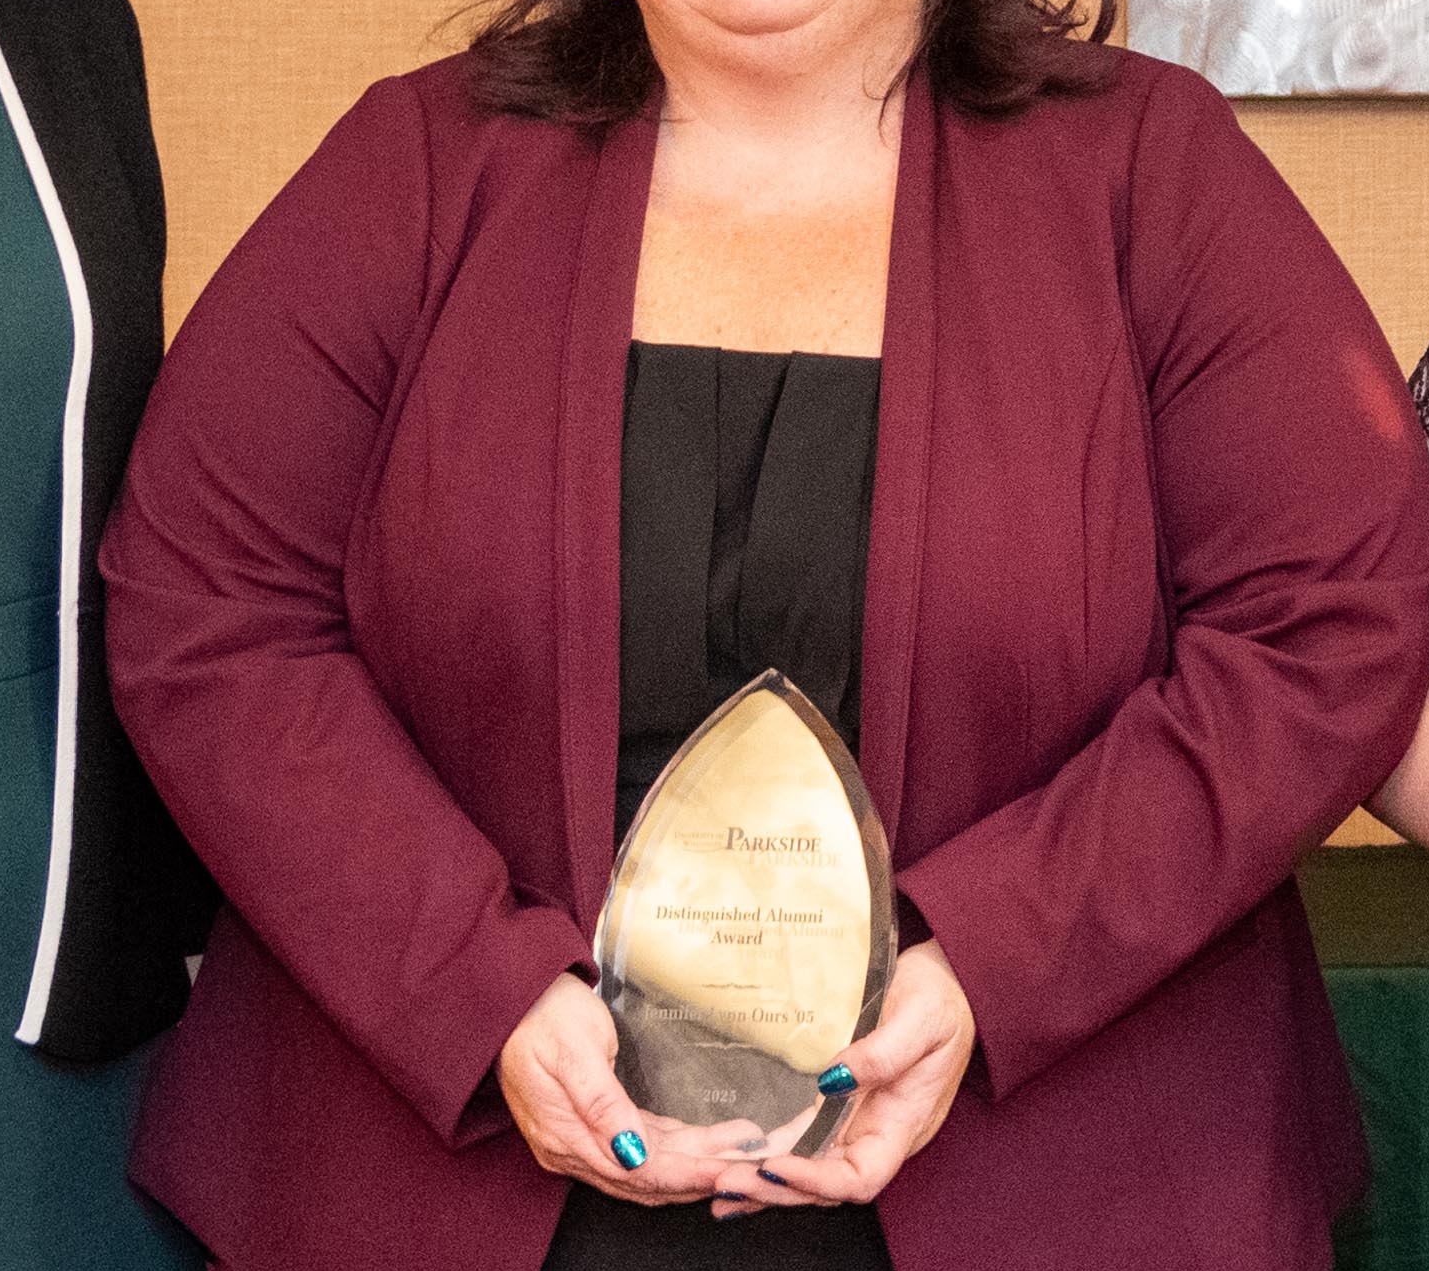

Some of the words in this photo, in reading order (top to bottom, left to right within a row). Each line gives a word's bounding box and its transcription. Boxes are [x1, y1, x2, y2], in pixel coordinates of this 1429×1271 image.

[725, 826, 822, 853] PARKSIDE
[656, 905, 761, 924] Distinguished
[765, 907, 824, 923] Alumni
[711, 930, 764, 945] Award
[751, 1007, 789, 1023] Ours
[793, 1008, 815, 1024] '05
[702, 1088, 737, 1103] 2025
